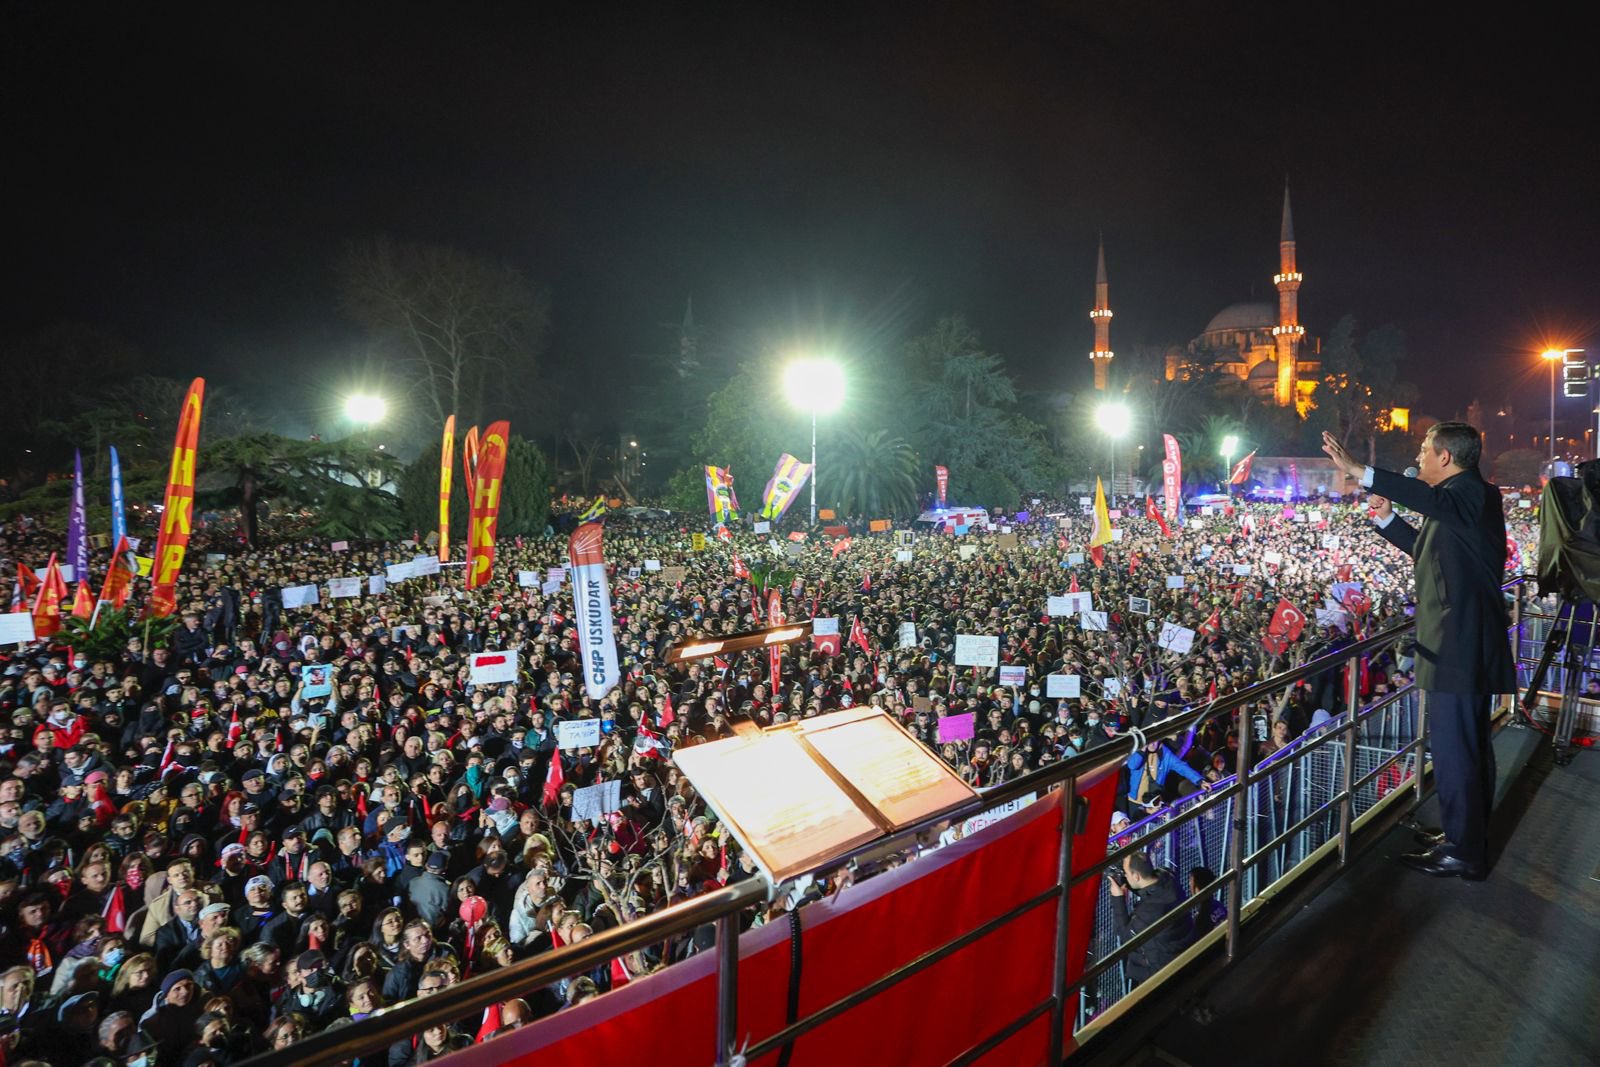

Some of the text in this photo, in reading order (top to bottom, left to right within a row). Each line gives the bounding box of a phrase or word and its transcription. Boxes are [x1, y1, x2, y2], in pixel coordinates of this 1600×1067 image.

[158, 447, 195, 583] HKP
[470, 478, 500, 587] HKP
[592, 650, 606, 686] CHP
